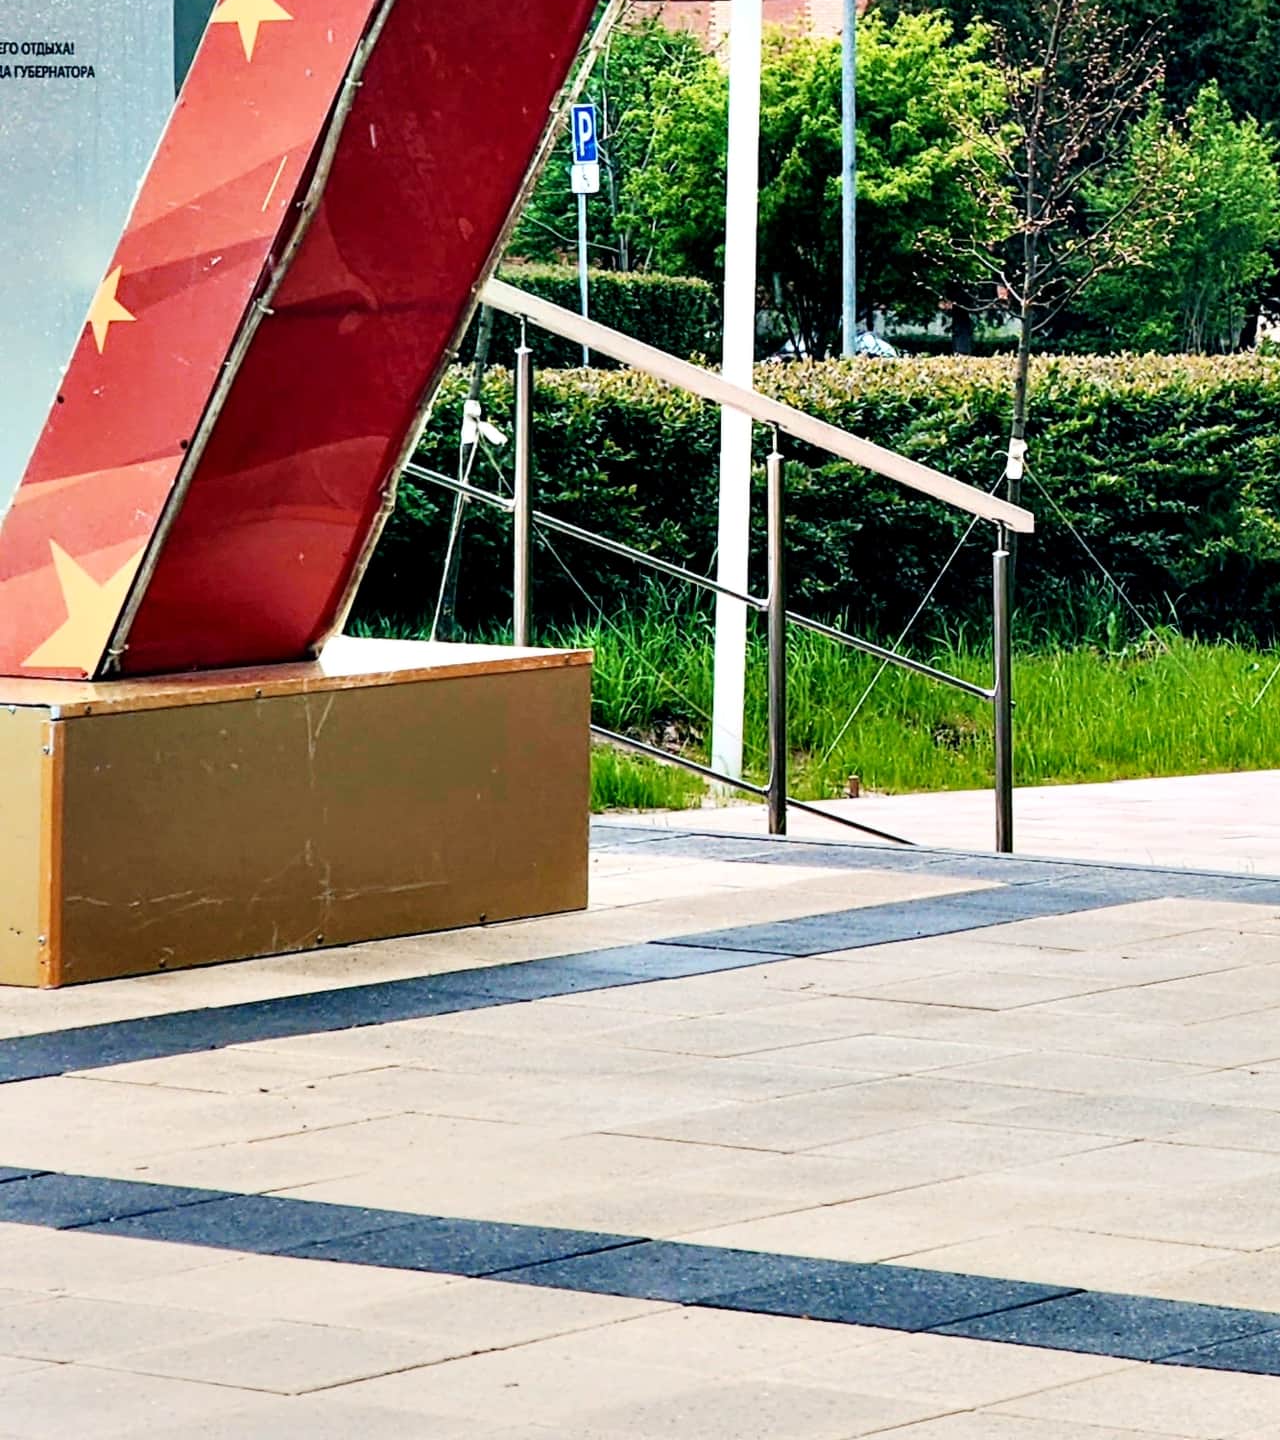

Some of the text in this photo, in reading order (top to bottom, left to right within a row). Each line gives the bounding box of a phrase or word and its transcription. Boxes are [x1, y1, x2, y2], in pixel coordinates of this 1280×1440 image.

[21, 42, 74, 56] ОТДЫХА!
[14, 65, 95, 79] ГУБЕРНАТОРА
[578, 111, 592, 156] P
